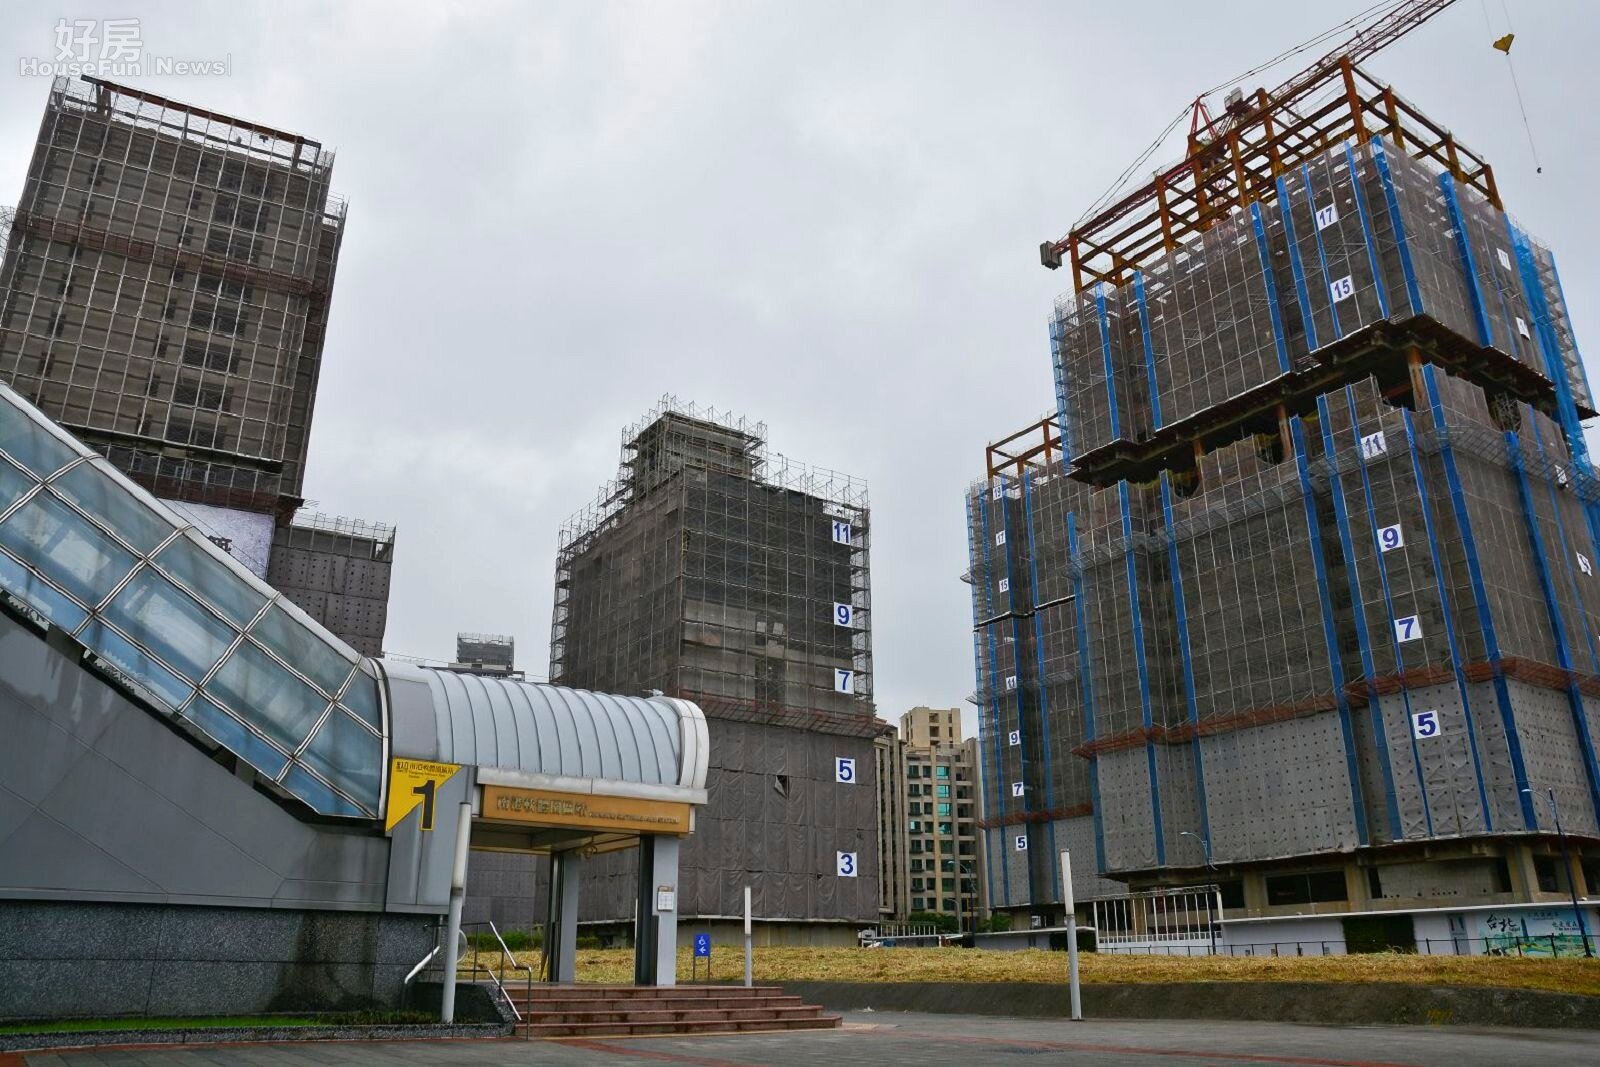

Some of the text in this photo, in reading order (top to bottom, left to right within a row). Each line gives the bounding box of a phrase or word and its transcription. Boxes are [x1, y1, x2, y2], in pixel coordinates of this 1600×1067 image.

[1319, 206, 1334, 226] 17
[1334, 279, 1350, 298] 15
[1364, 434, 1386, 456] 11
[834, 522, 850, 543] 11
[1382, 527, 1399, 549] 9
[1000, 582, 1008, 593] 15
[837, 605, 850, 625] 9
[1398, 617, 1415, 639] 7
[838, 670, 850, 691] 7
[1007, 678, 1016, 689] 11
[1418, 712, 1436, 736] 5
[1010, 732, 1018, 744] 9
[839, 760, 853, 781] 5
[1014, 783, 1022, 795] 7
[413, 780, 435, 829] 1
[1018, 836, 1026, 849] 5
[841, 853, 854, 874] 3
[1486, 913, 1517, 932] 台北
